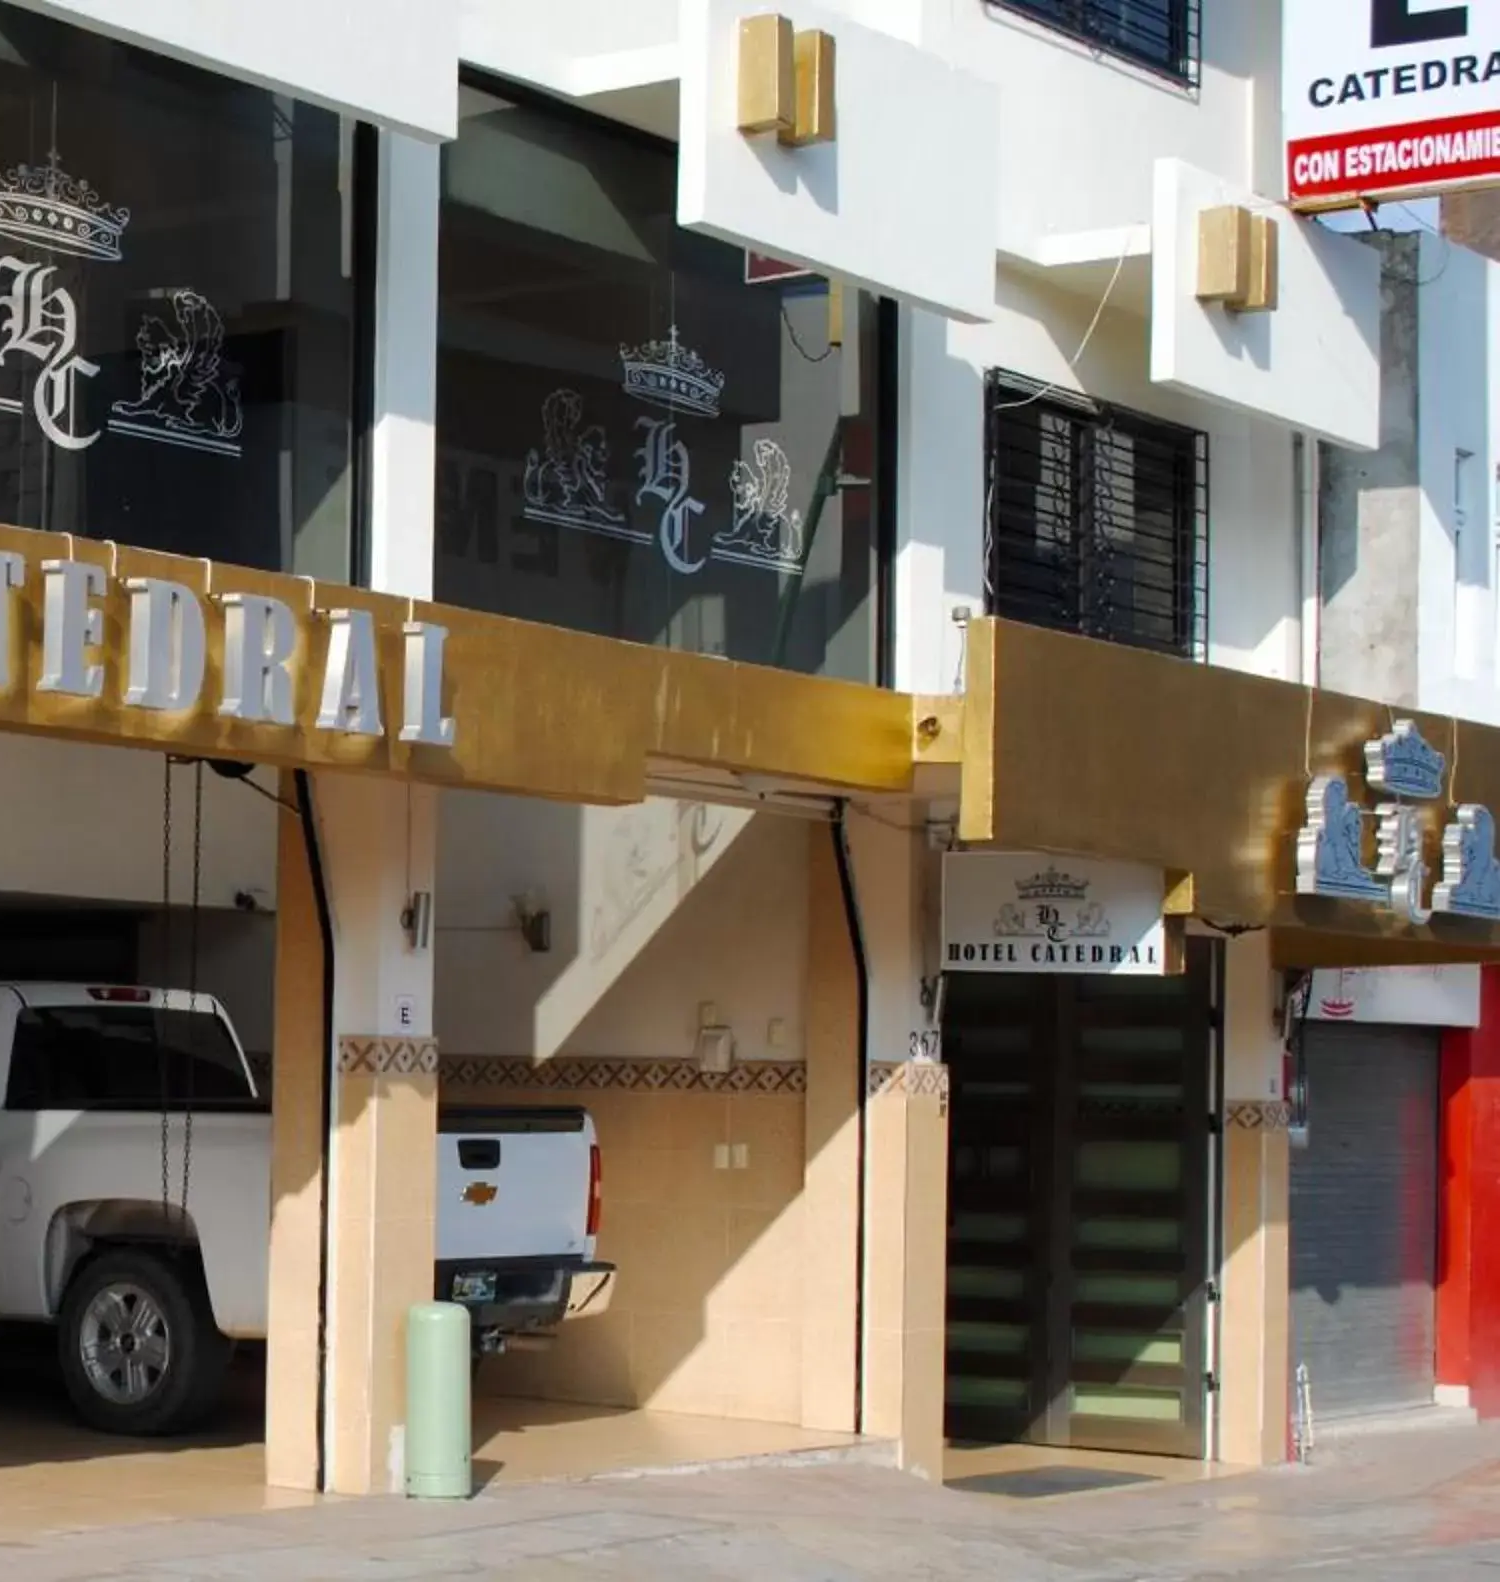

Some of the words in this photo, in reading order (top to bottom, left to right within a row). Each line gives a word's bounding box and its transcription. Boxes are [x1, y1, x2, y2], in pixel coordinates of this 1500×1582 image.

[1308, 51, 1500, 108] CATEDRA
[1294, 150, 1340, 186] CON
[1345, 126, 1500, 178] ESTACIONAMIE
[947, 943, 1018, 962] HOTEL
[1031, 944, 1158, 964] CATEDRAL
[401, 1007, 411, 1025] E
